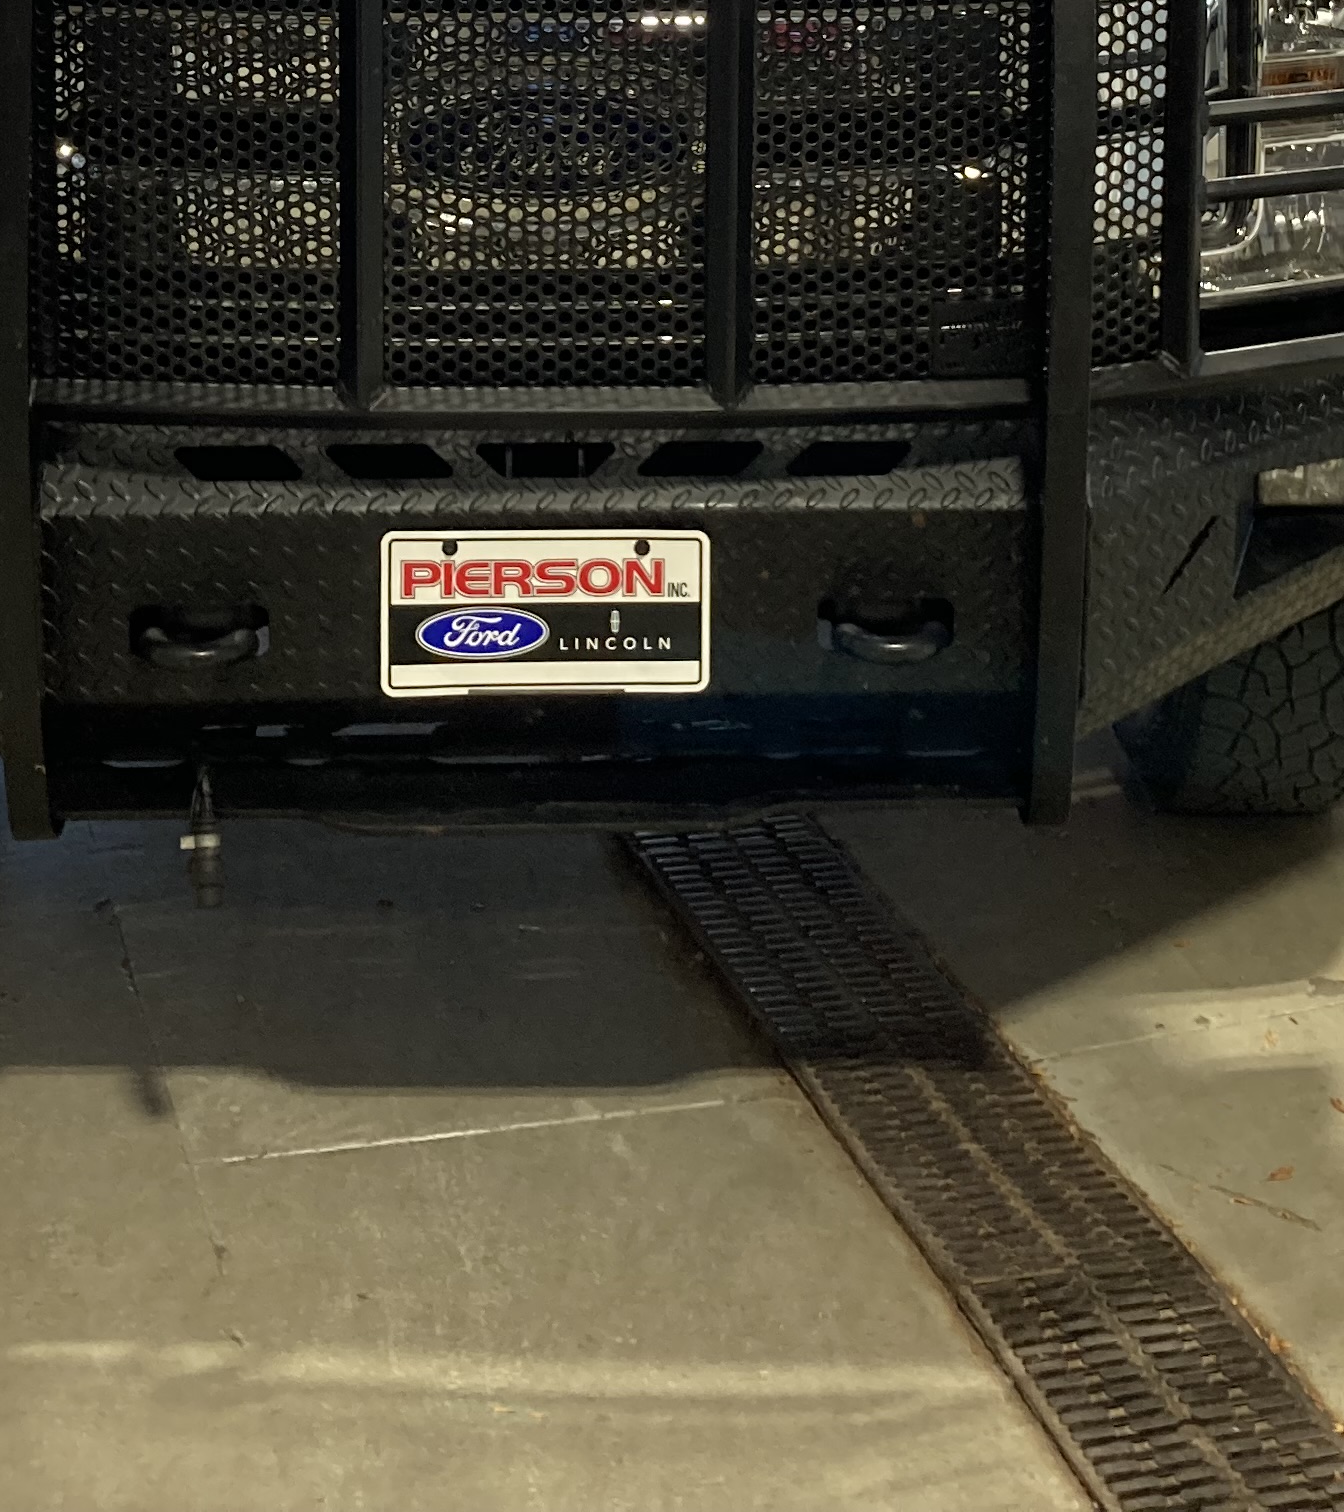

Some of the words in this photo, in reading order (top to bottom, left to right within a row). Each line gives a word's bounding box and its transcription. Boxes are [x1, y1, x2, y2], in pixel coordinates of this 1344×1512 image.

[400, 558, 666, 600] PIERSON
[667, 582, 691, 598] INC.
[444, 615, 520, 647] Ford
[559, 637, 672, 651] LINCOLN
